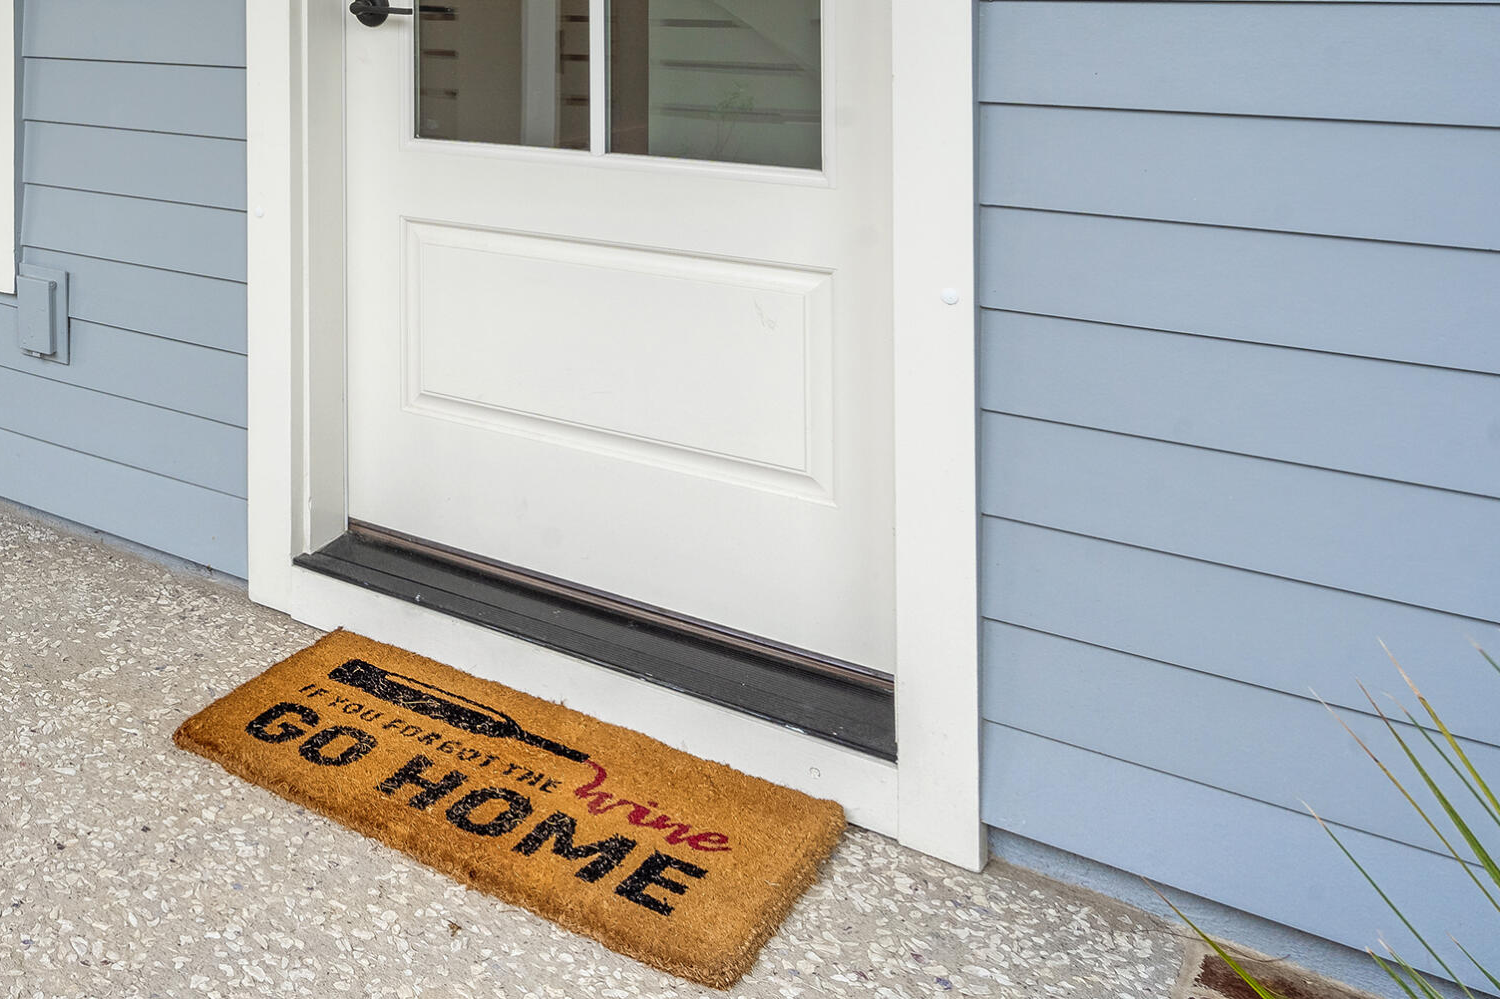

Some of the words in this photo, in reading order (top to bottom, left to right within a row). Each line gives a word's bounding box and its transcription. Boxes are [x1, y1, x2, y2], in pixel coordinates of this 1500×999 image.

[244, 701, 378, 767] GO
[374, 754, 709, 916] HOME
[298, 683, 330, 698] IF
[328, 695, 384, 722] YOU
[382, 718, 500, 767] FORGOT
[502, 763, 562, 793] THE
